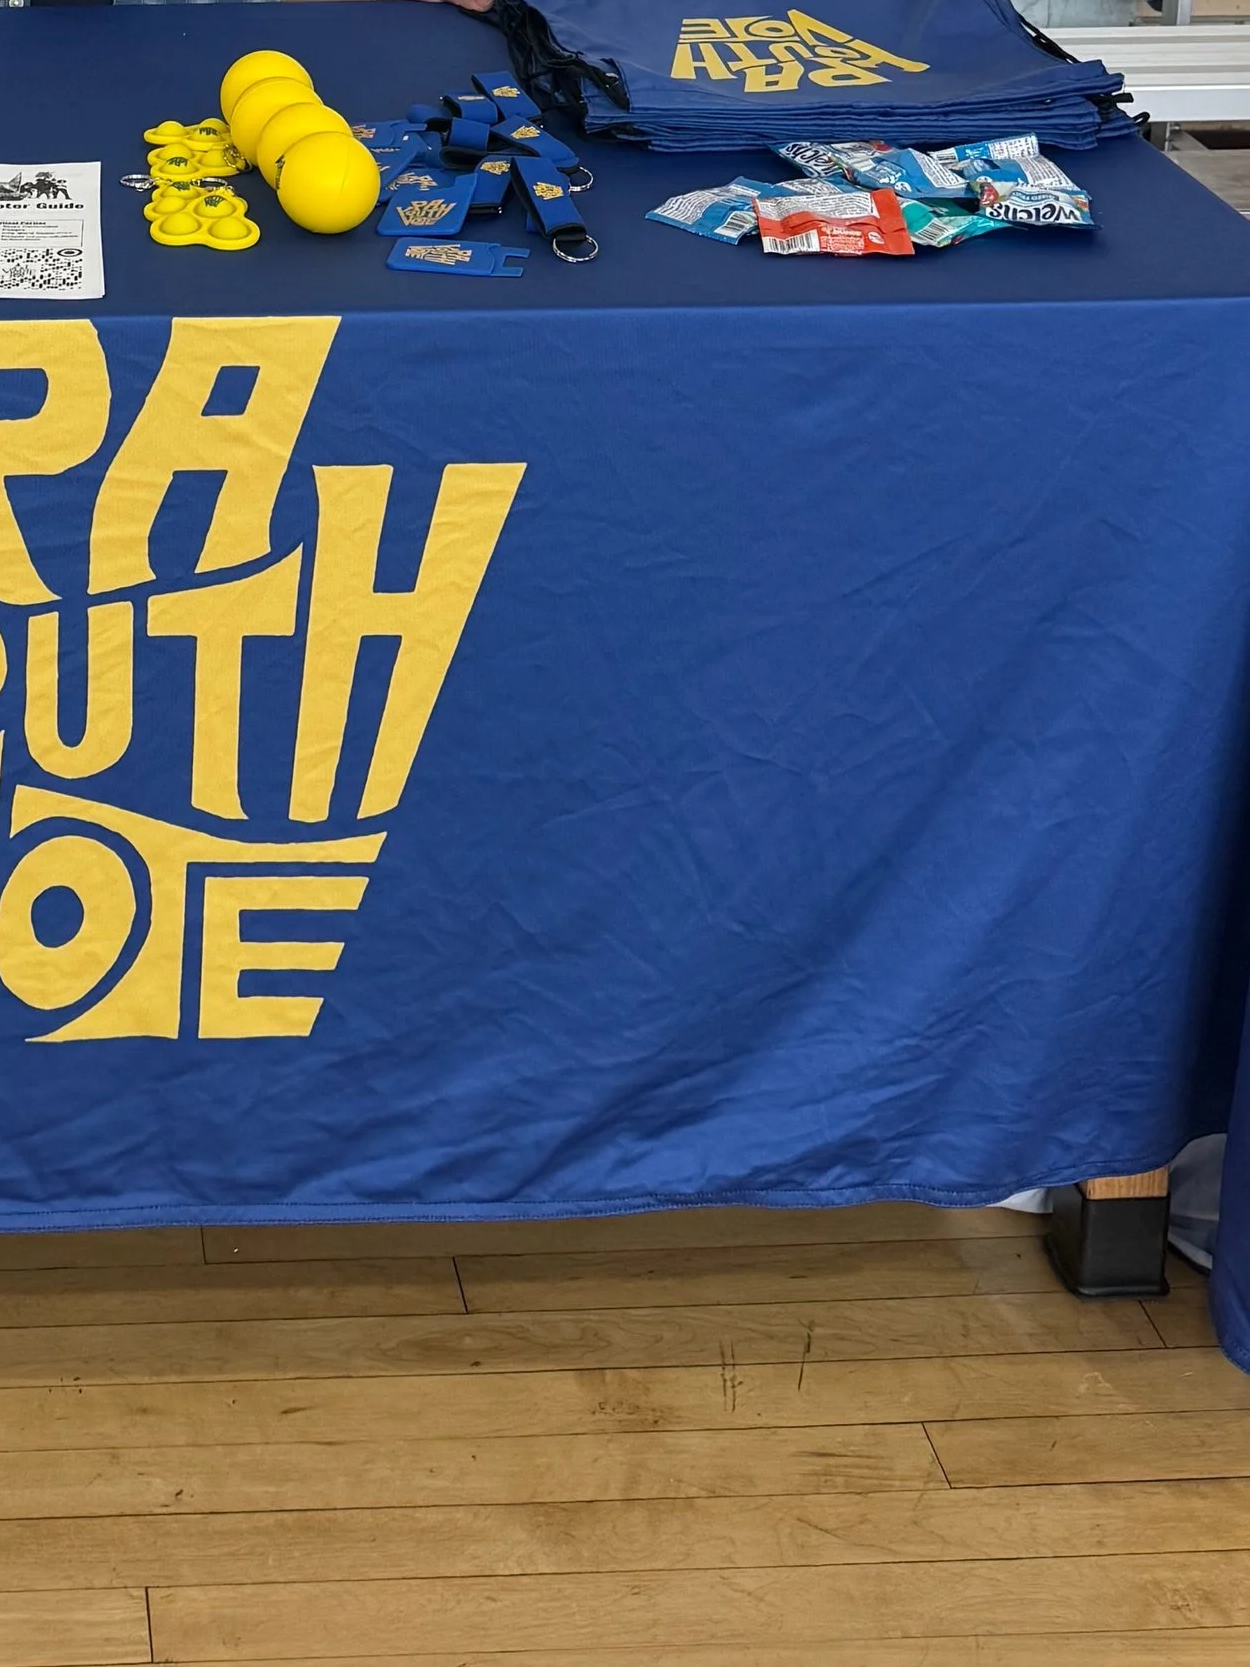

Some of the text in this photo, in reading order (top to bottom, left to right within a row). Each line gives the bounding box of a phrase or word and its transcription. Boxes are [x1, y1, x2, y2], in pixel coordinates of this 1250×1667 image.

[678, 9, 853, 46] VOTE
[670, 38, 930, 79] YOUTH
[36, 202, 84, 210] Guide
